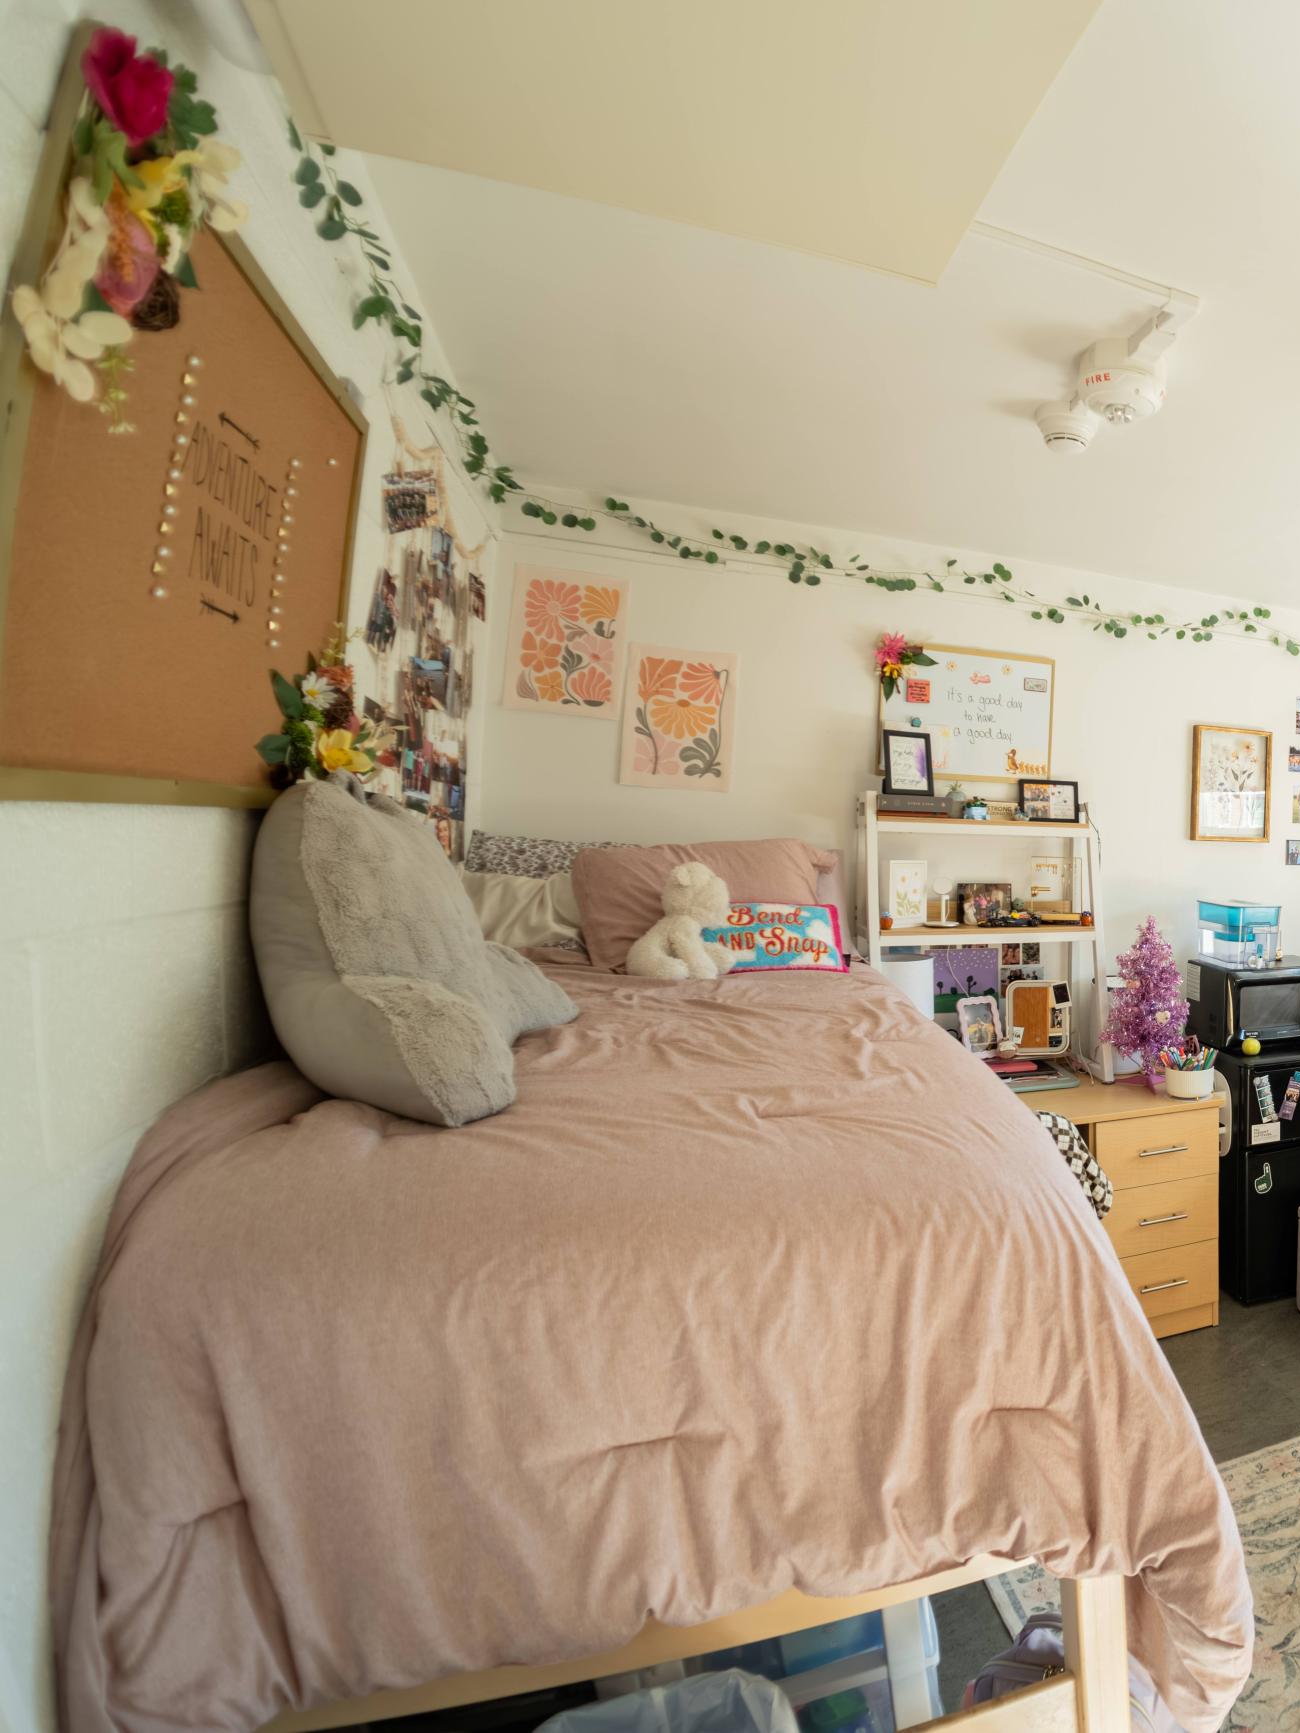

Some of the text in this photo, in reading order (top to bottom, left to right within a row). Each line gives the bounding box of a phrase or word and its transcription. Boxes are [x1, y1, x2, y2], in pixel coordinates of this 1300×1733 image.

[1085, 373, 1111, 387] FIRE
[181, 421, 277, 541] ADVENTURE
[189, 505, 258, 607] AWAITS
[967, 695, 975, 703] a
[977, 693, 1002, 712] good
[1006, 697, 1023, 712] day
[964, 710, 996, 723] to have
[953, 727, 1013, 745] a good day
[726, 906, 804, 926] Bend
[758, 927, 829, 963] Snap
